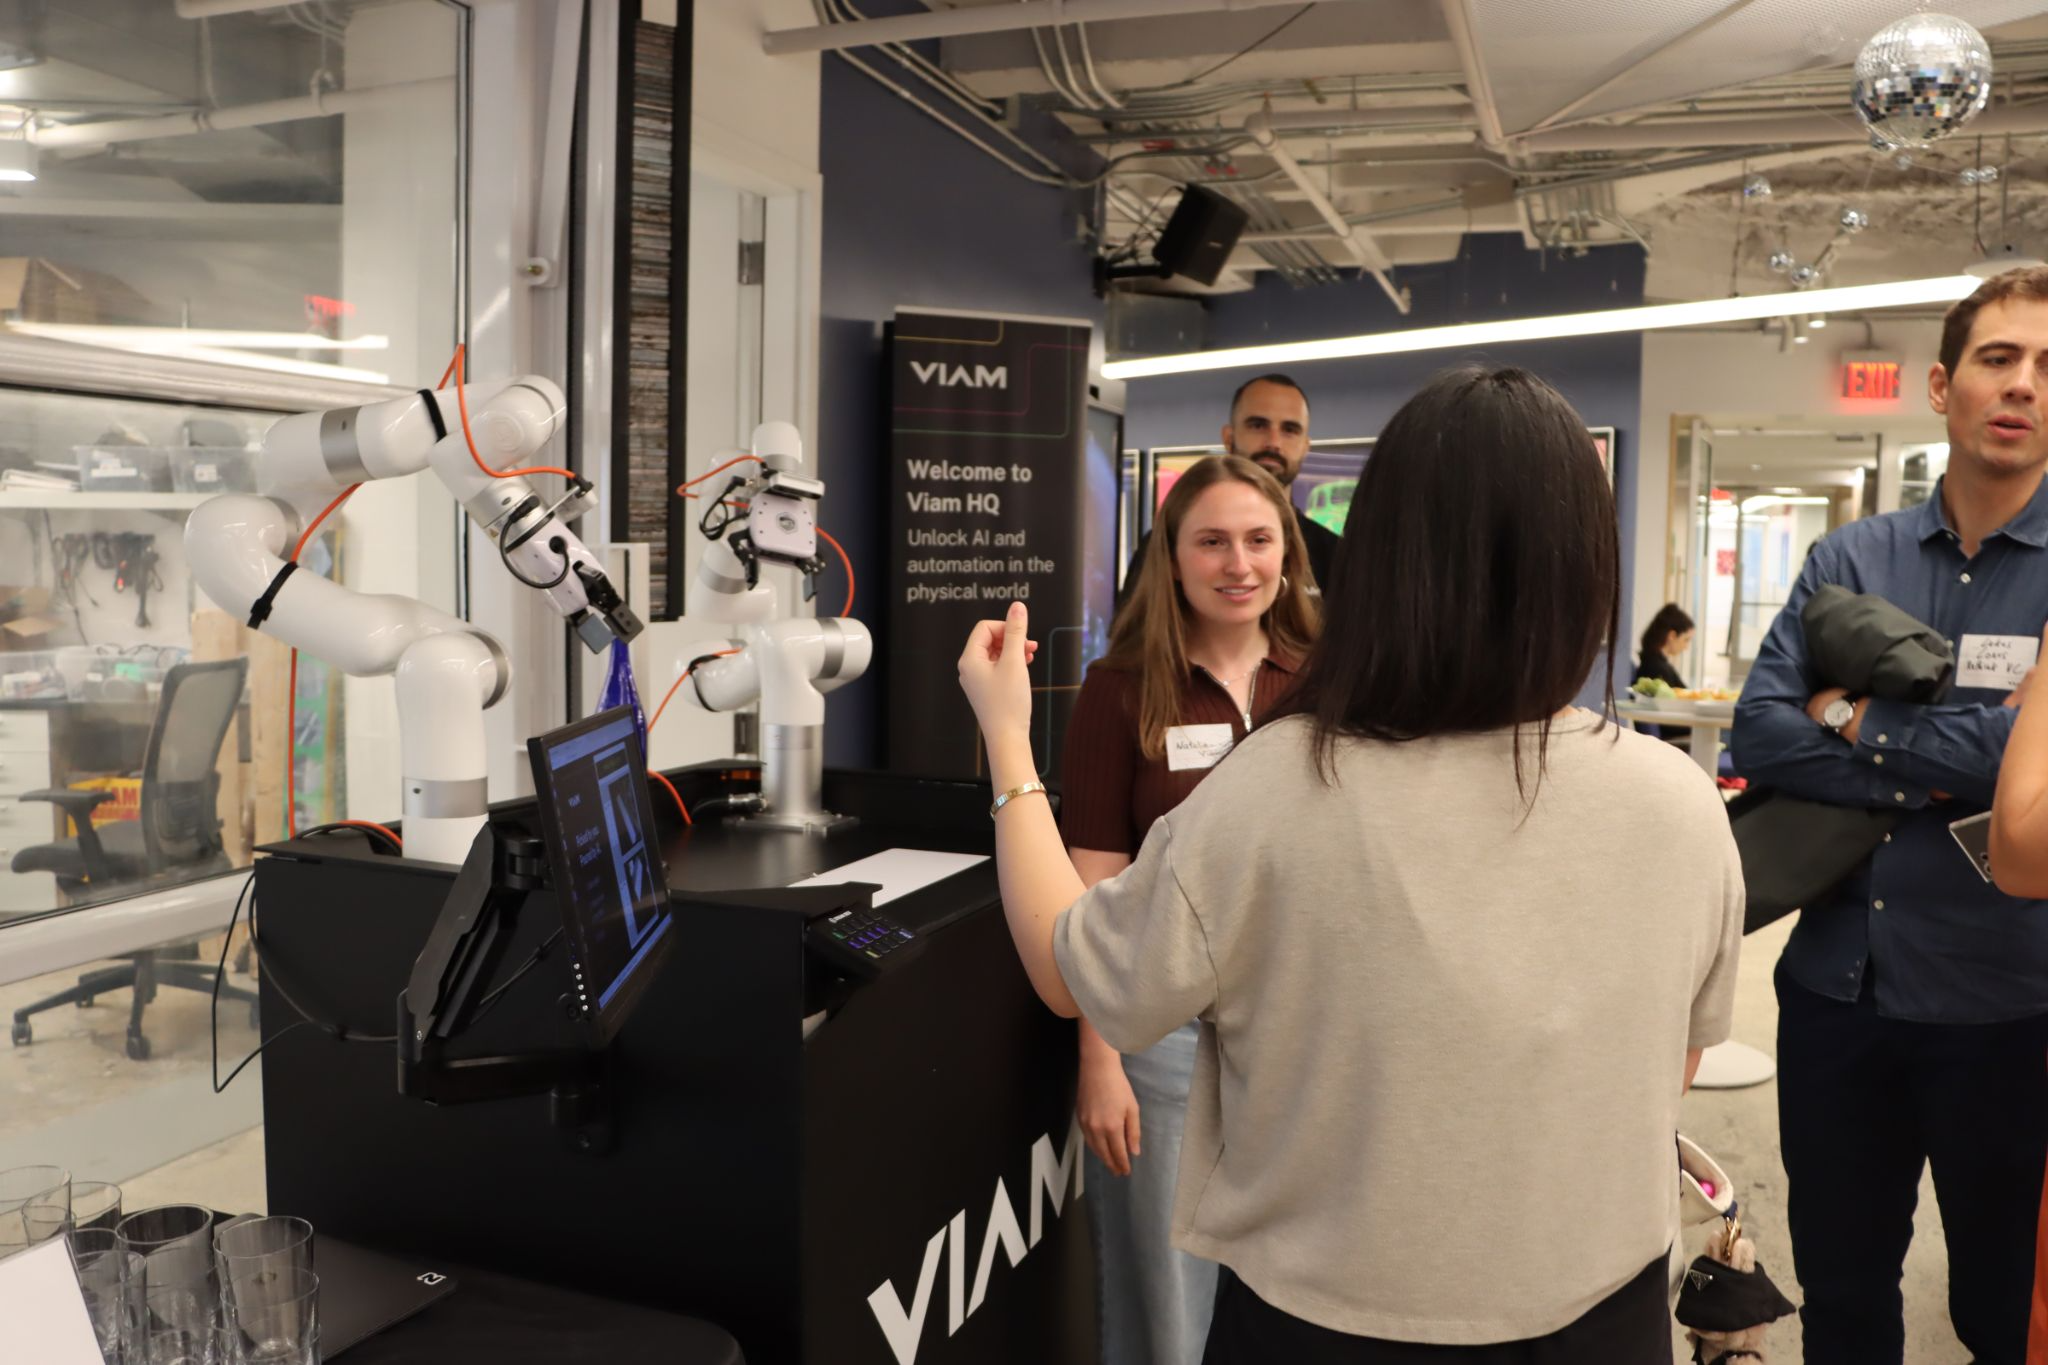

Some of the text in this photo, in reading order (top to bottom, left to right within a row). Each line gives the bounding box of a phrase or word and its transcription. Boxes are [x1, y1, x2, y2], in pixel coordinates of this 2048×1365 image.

[910, 361, 1008, 389] VIAM
[1849, 362, 1899, 398] EXIT
[907, 459, 1033, 482] Welcome to
[906, 492, 1001, 515] Viam HQ
[908, 529, 1026, 546] Unlock AI and
[907, 556, 1055, 573] automation in the
[907, 582, 1030, 602] physical world
[867, 1108, 1085, 1365] VIAM
